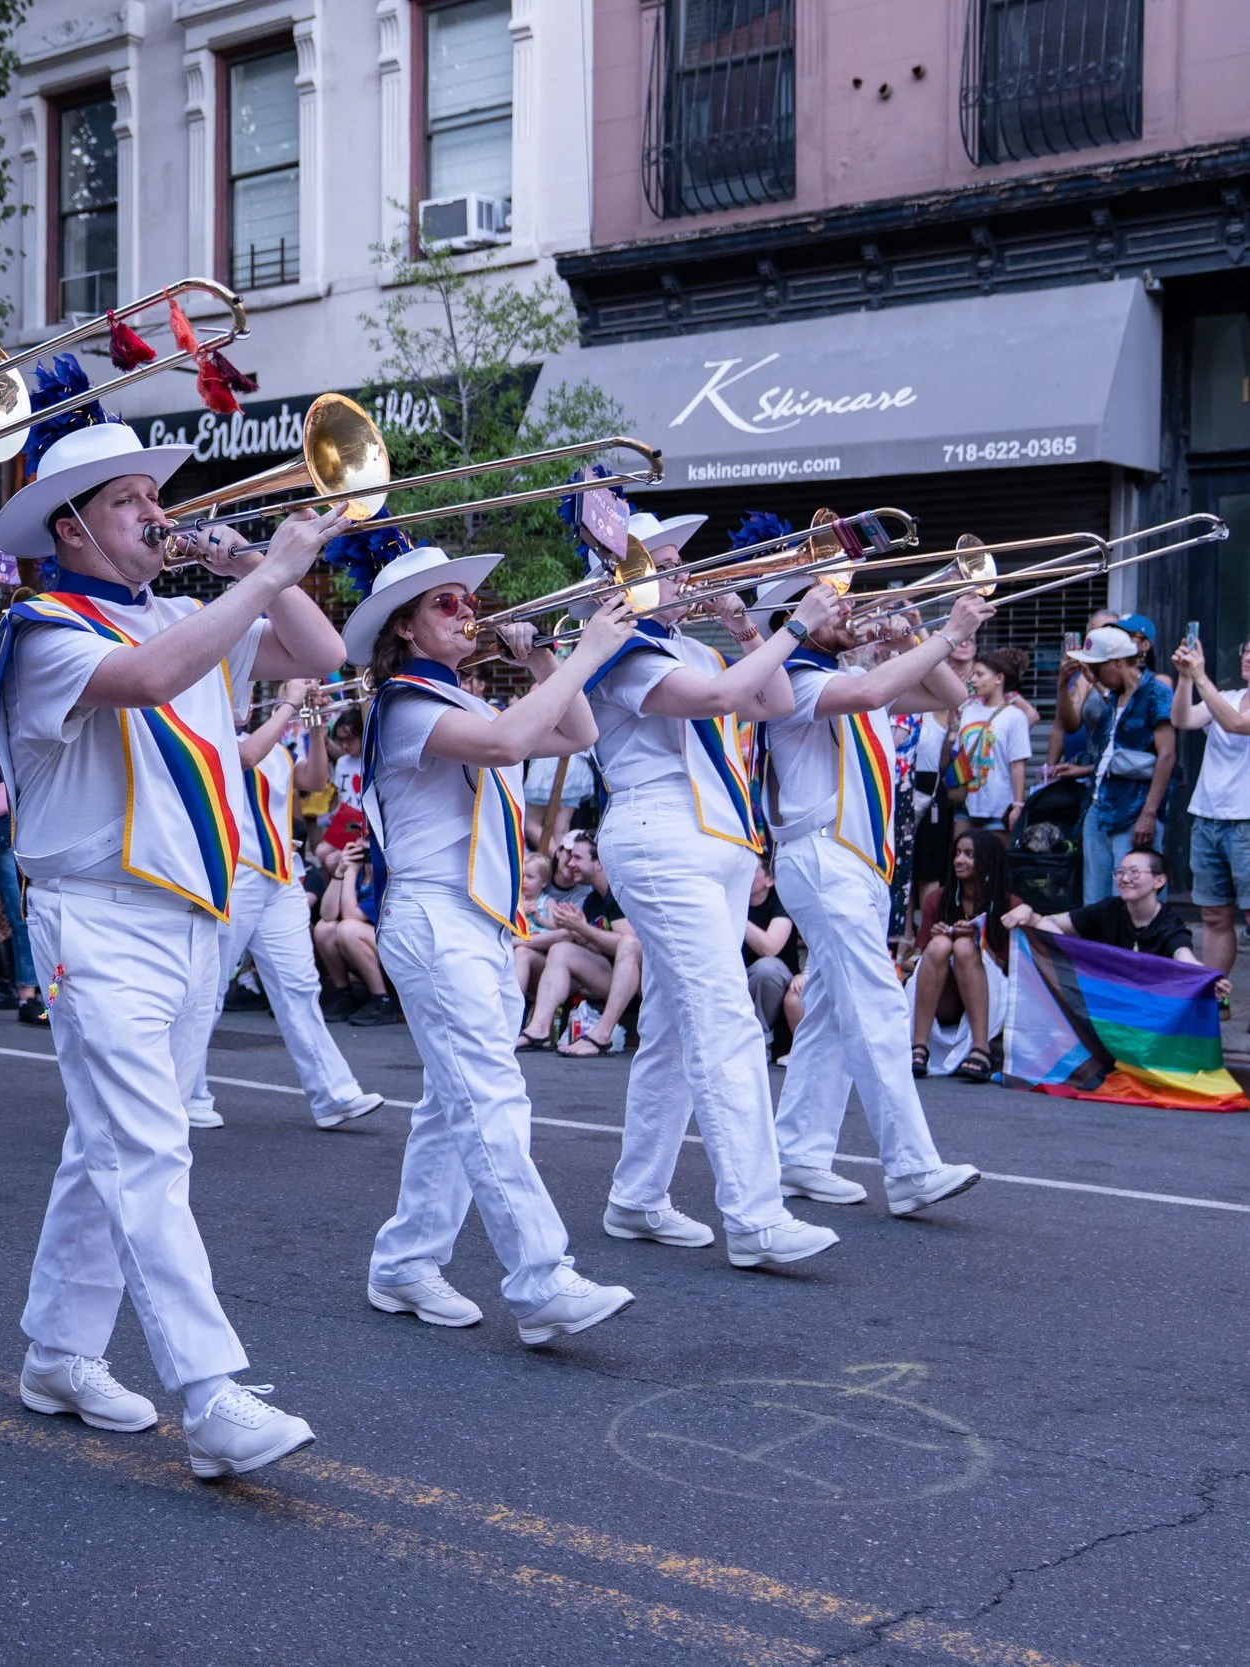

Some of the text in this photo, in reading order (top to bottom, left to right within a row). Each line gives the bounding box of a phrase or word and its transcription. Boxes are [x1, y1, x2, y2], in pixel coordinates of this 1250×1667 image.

[669, 353, 918, 434] K Skincare
[192, 403, 302, 463] Enfants
[943, 436, 1078, 463] 718-622-0365
[687, 456, 841, 482] kskincarenyc.com
